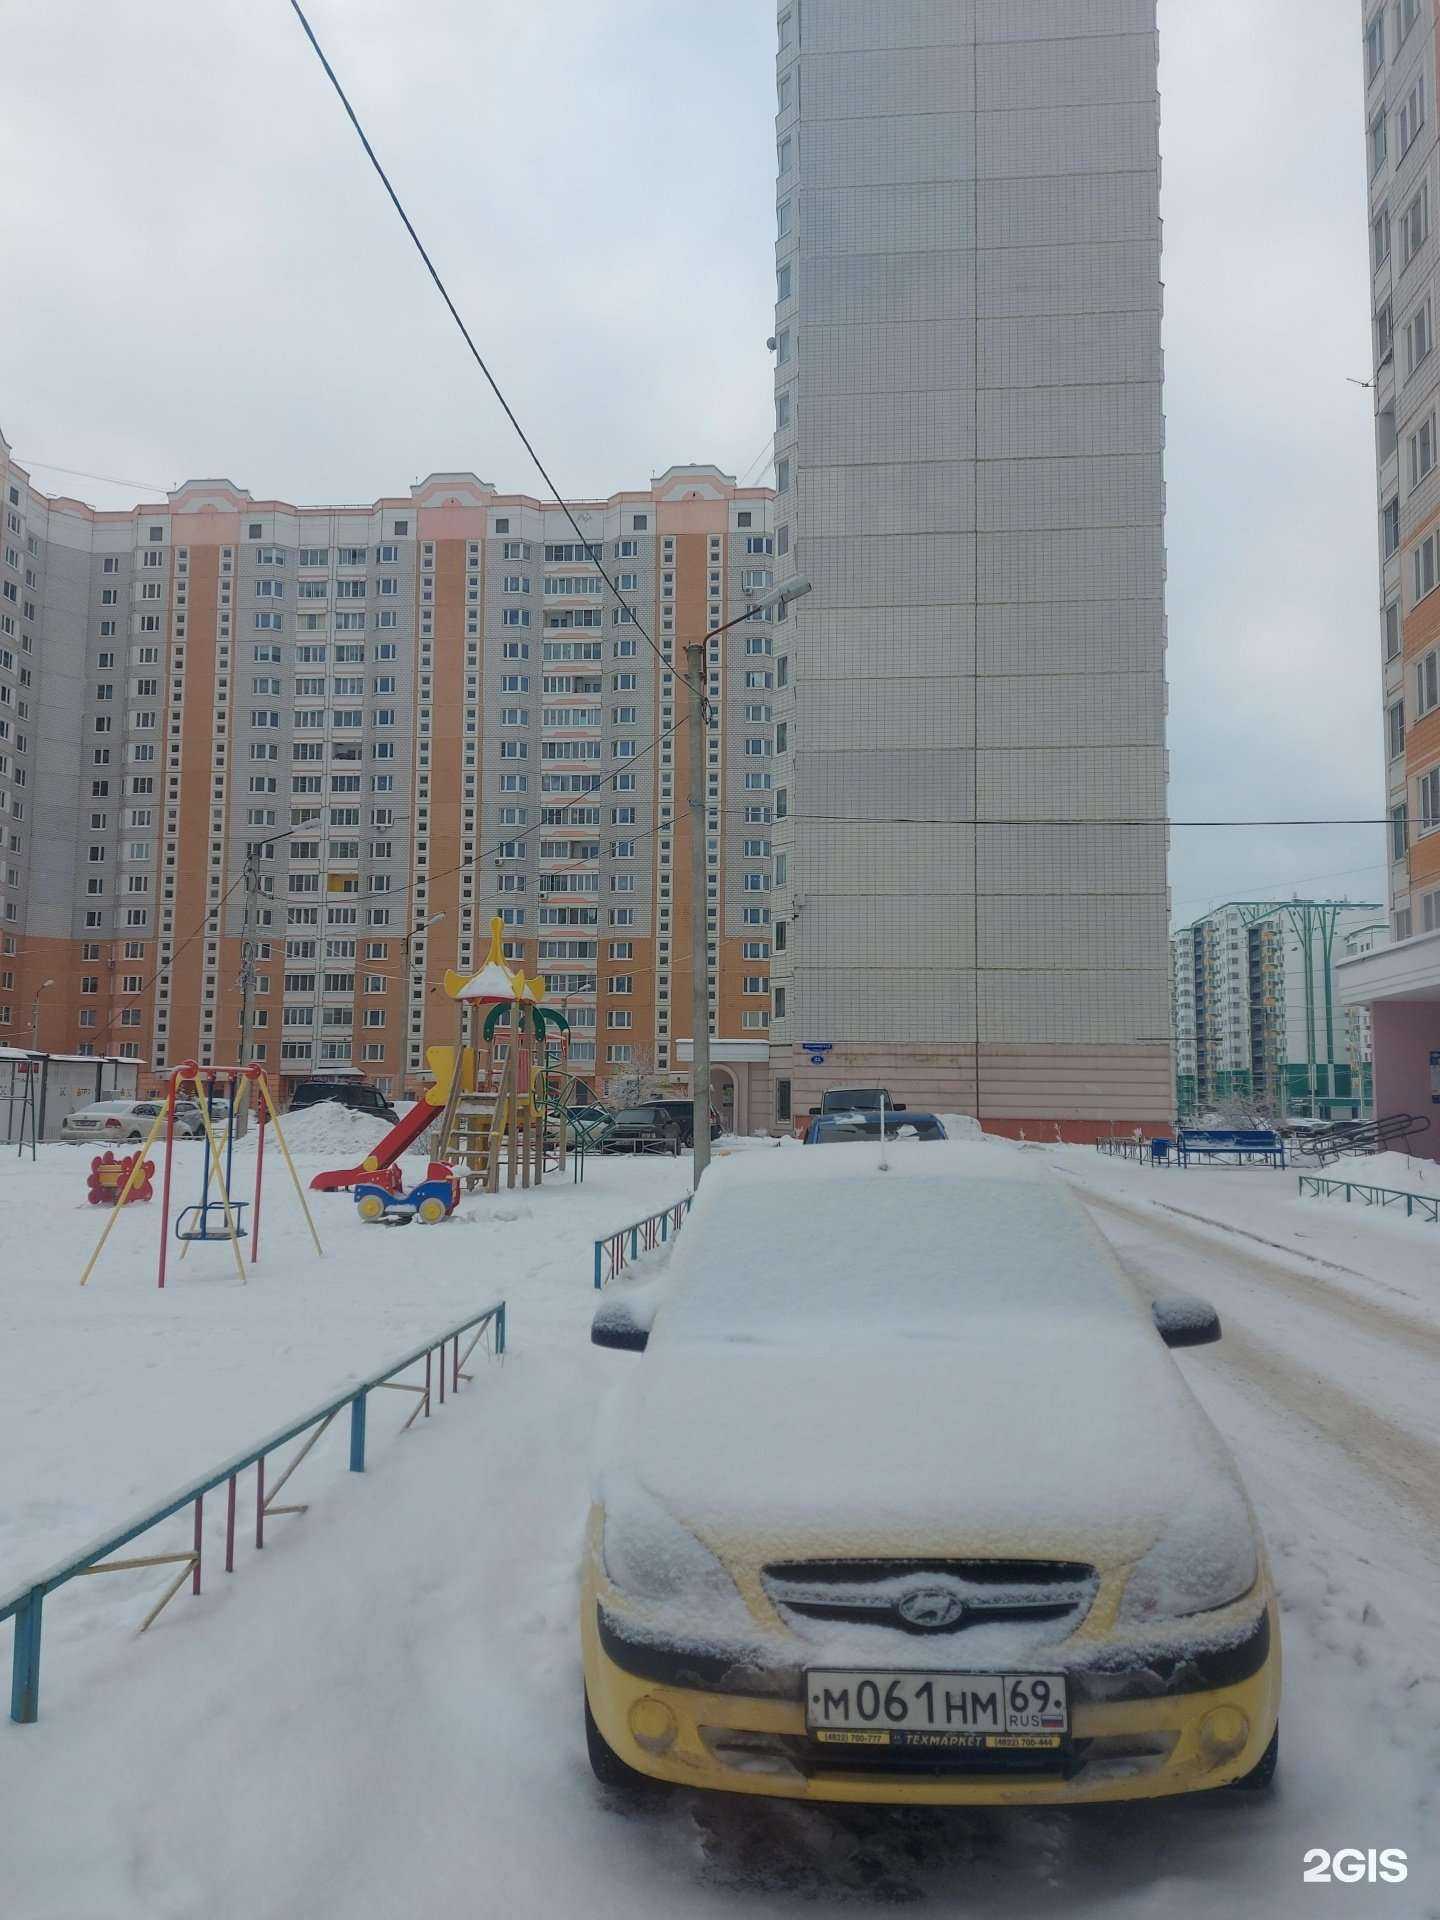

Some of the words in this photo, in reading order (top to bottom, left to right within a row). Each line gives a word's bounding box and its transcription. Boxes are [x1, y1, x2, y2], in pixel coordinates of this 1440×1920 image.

[823, 1680, 998, 1725] М061НМ
[1009, 1680, 1051, 1713] 69
[1009, 1714, 1040, 1728] RUS
